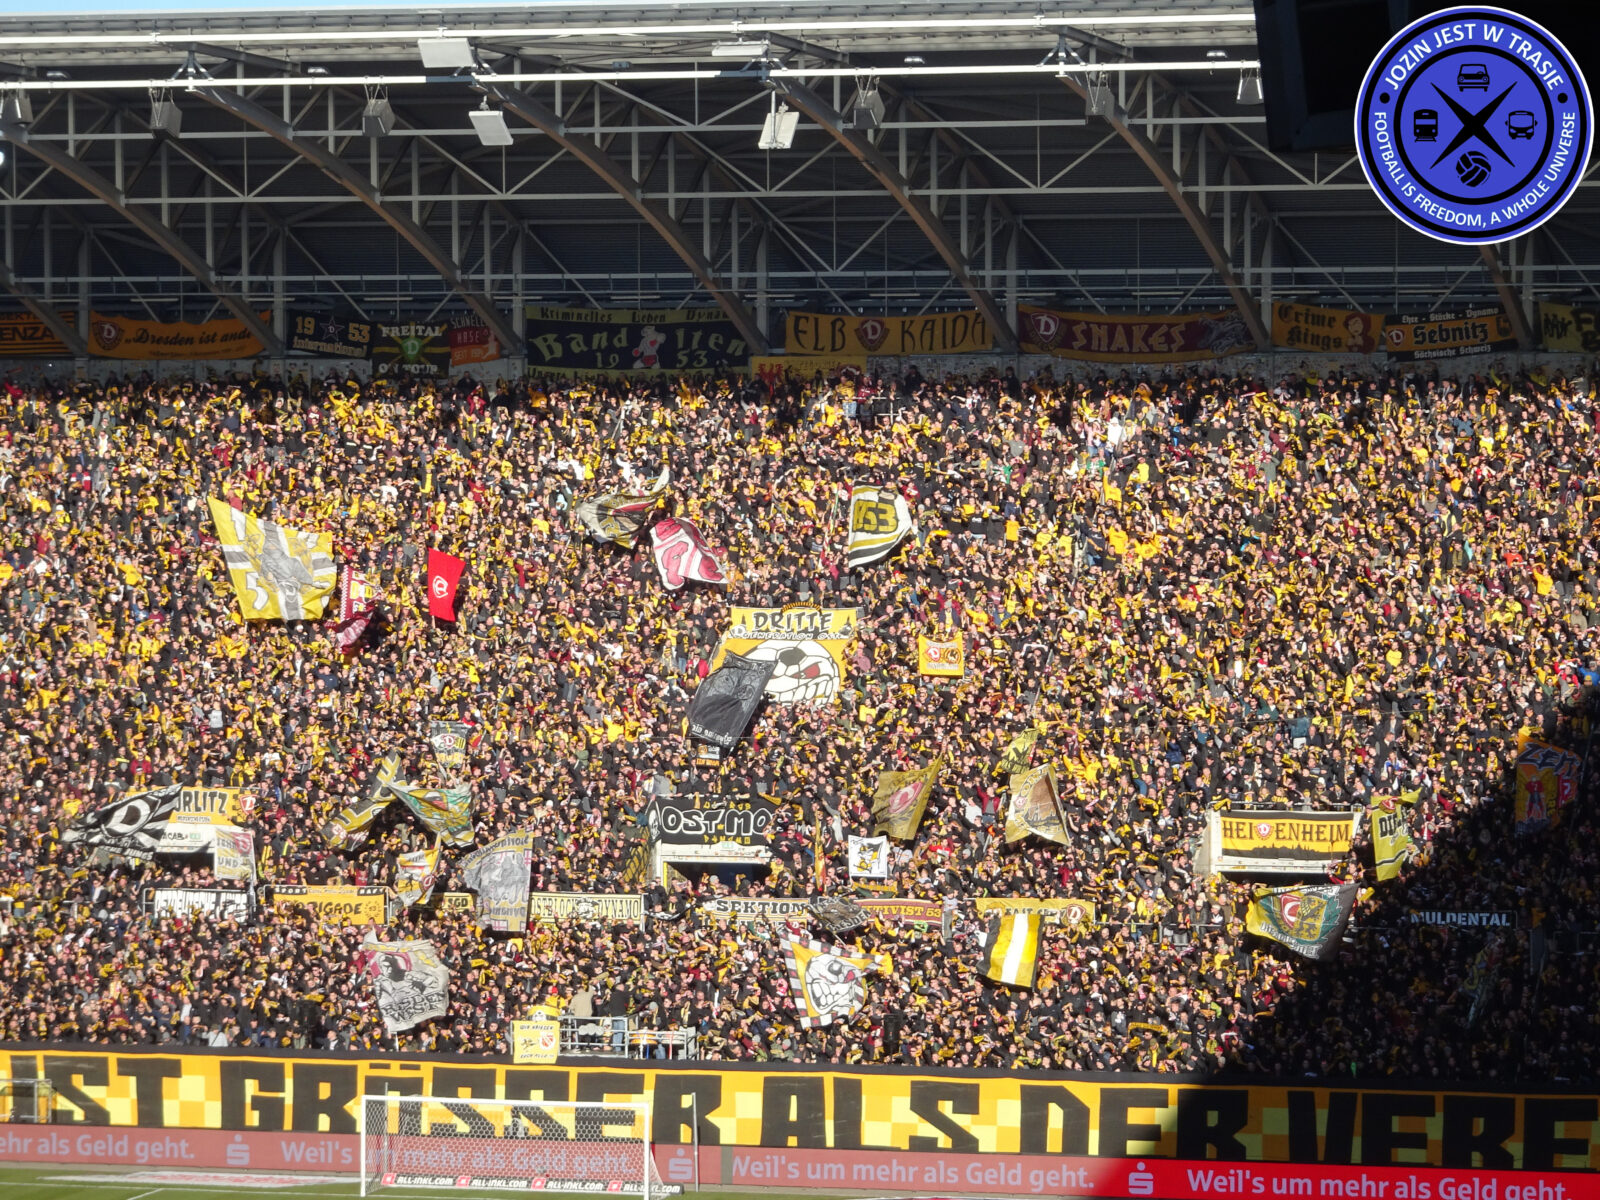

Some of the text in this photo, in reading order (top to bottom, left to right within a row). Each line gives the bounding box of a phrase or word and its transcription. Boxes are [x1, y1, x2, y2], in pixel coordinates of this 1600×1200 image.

[296, 316, 316, 335] 19
[348, 323, 371, 342] 53
[381, 325, 443, 338] FREITAL
[794, 315, 846, 352] ELB
[901, 311, 987, 352] KAIDA
[1413, 321, 1489, 346] Sebnitz
[1072, 321, 1186, 353] SNAKES
[753, 612, 833, 631] DRITTE
[599, 900, 640, 919] DYNAMO
[716, 900, 806, 915] SEKTION
[926, 905, 942, 918] 53
[760, 1076, 980, 1154] ALS
[1020, 1084, 1249, 1161] DER
[37, 1133, 69, 1156] als
[76, 1134, 129, 1157] Geld
[136, 1136, 196, 1163] geht.
[281, 1139, 353, 1164] Weil's
[397, 1175, 453, 1186] ALL-INKL.COM
[732, 1155, 1094, 1192] Weil's um mehr als Geld geht.
[471, 1178, 528, 1189] ALL-INKL.COM
[547, 1180, 605, 1191] ALL-INKL.COM
[1187, 1168, 1265, 1194] Weil's
[1272, 1175, 1312, 1196] um
[1320, 1173, 1389, 1198] mehr
[1395, 1175, 1431, 1200] als
[1439, 1177, 1498, 1200] Geld
